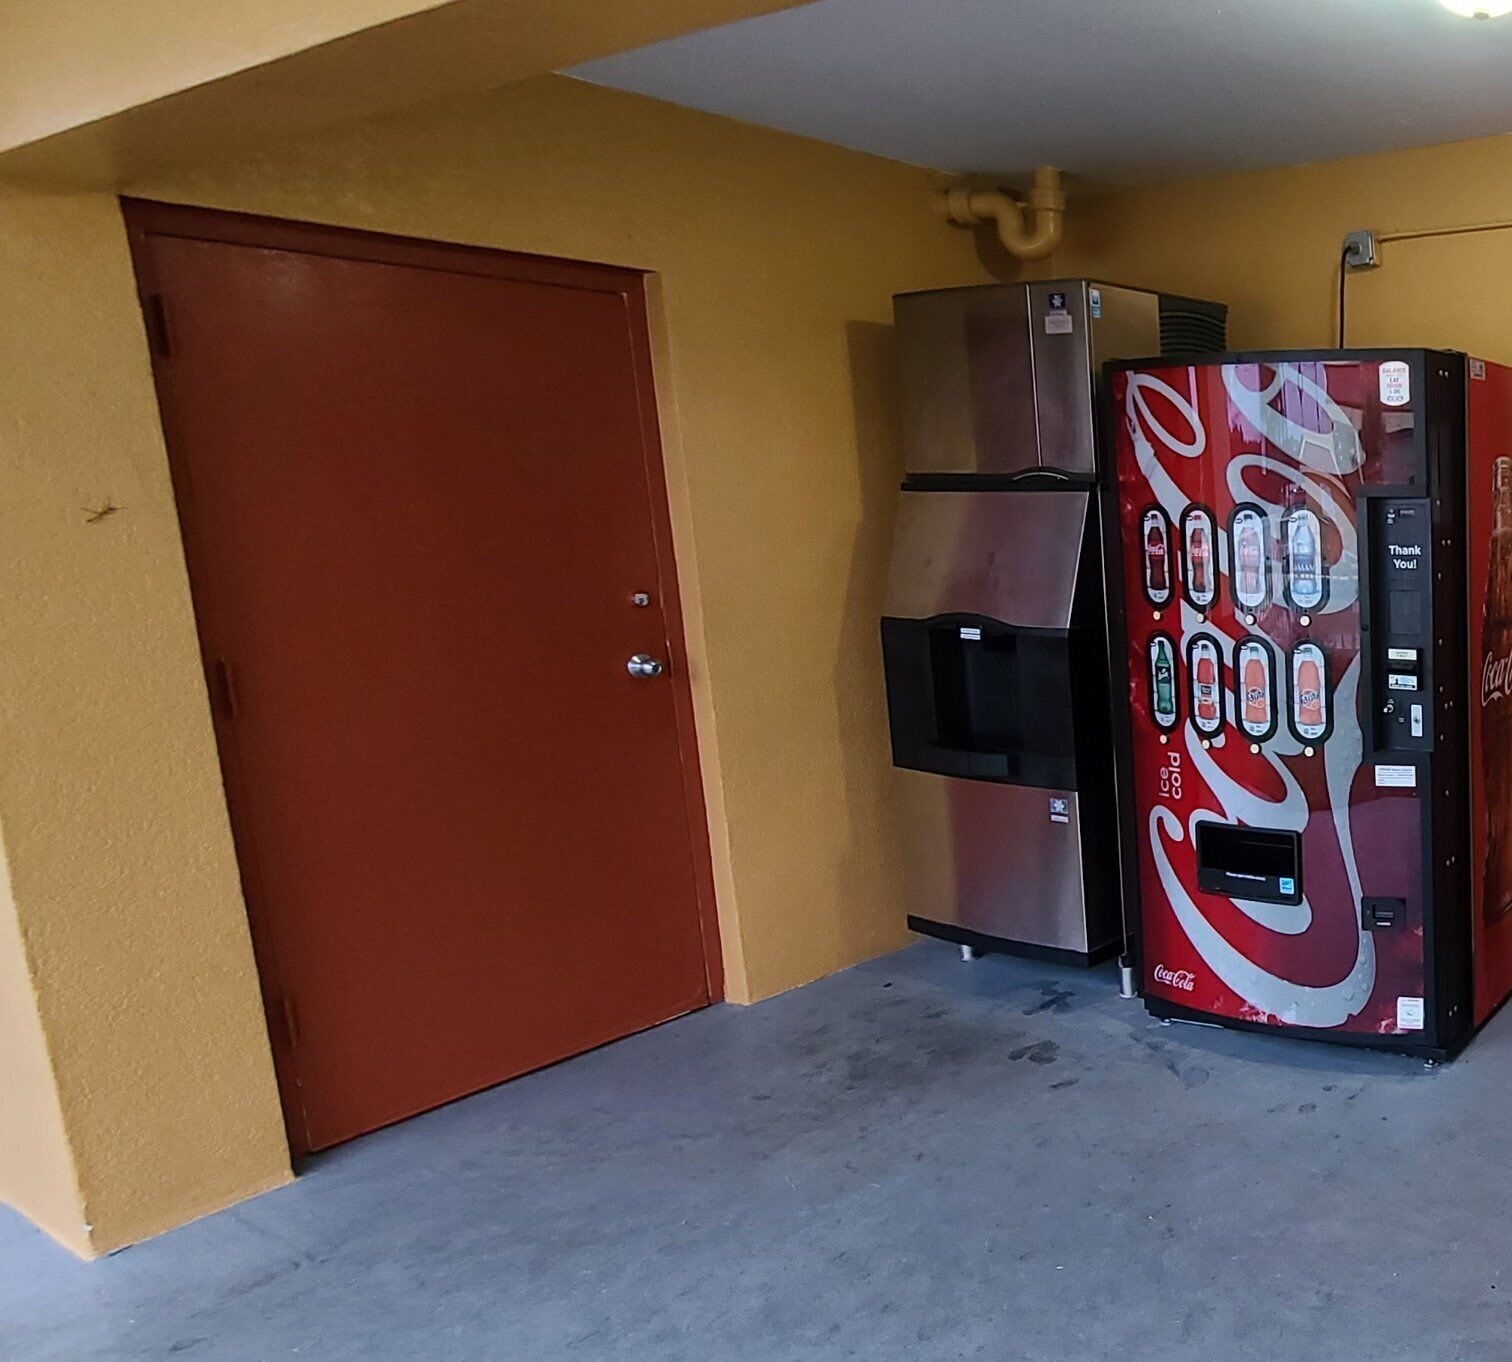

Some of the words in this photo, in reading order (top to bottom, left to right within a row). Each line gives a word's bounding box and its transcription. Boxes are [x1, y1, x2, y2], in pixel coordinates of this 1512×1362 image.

[1388, 545, 1421, 555] Thank
[1393, 559, 1417, 569] You!
[1158, 767, 1170, 798] ice
[1167, 751, 1182, 800] cold
